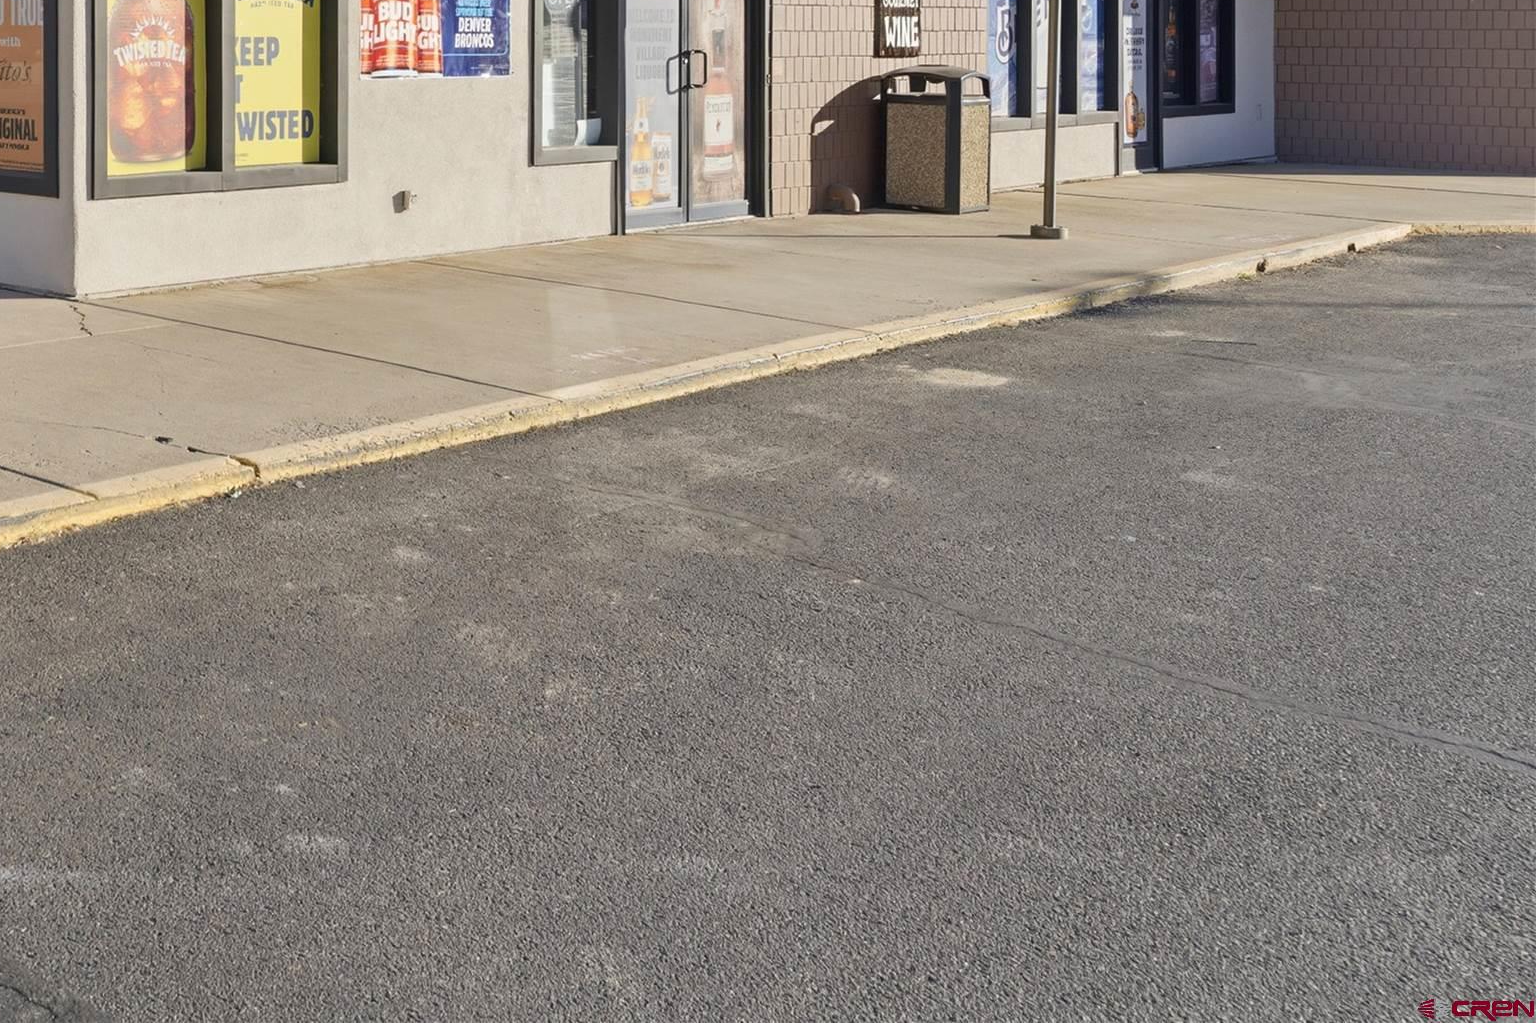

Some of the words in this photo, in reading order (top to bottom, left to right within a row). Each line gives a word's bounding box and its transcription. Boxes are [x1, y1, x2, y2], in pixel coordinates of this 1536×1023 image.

[378, 0, 412, 22] BUD
[458, 18, 492, 33] DENVER
[884, 15, 920, 48] WINE
[454, 33, 495, 49] BRONCOS
[236, 109, 315, 142] WISTED
